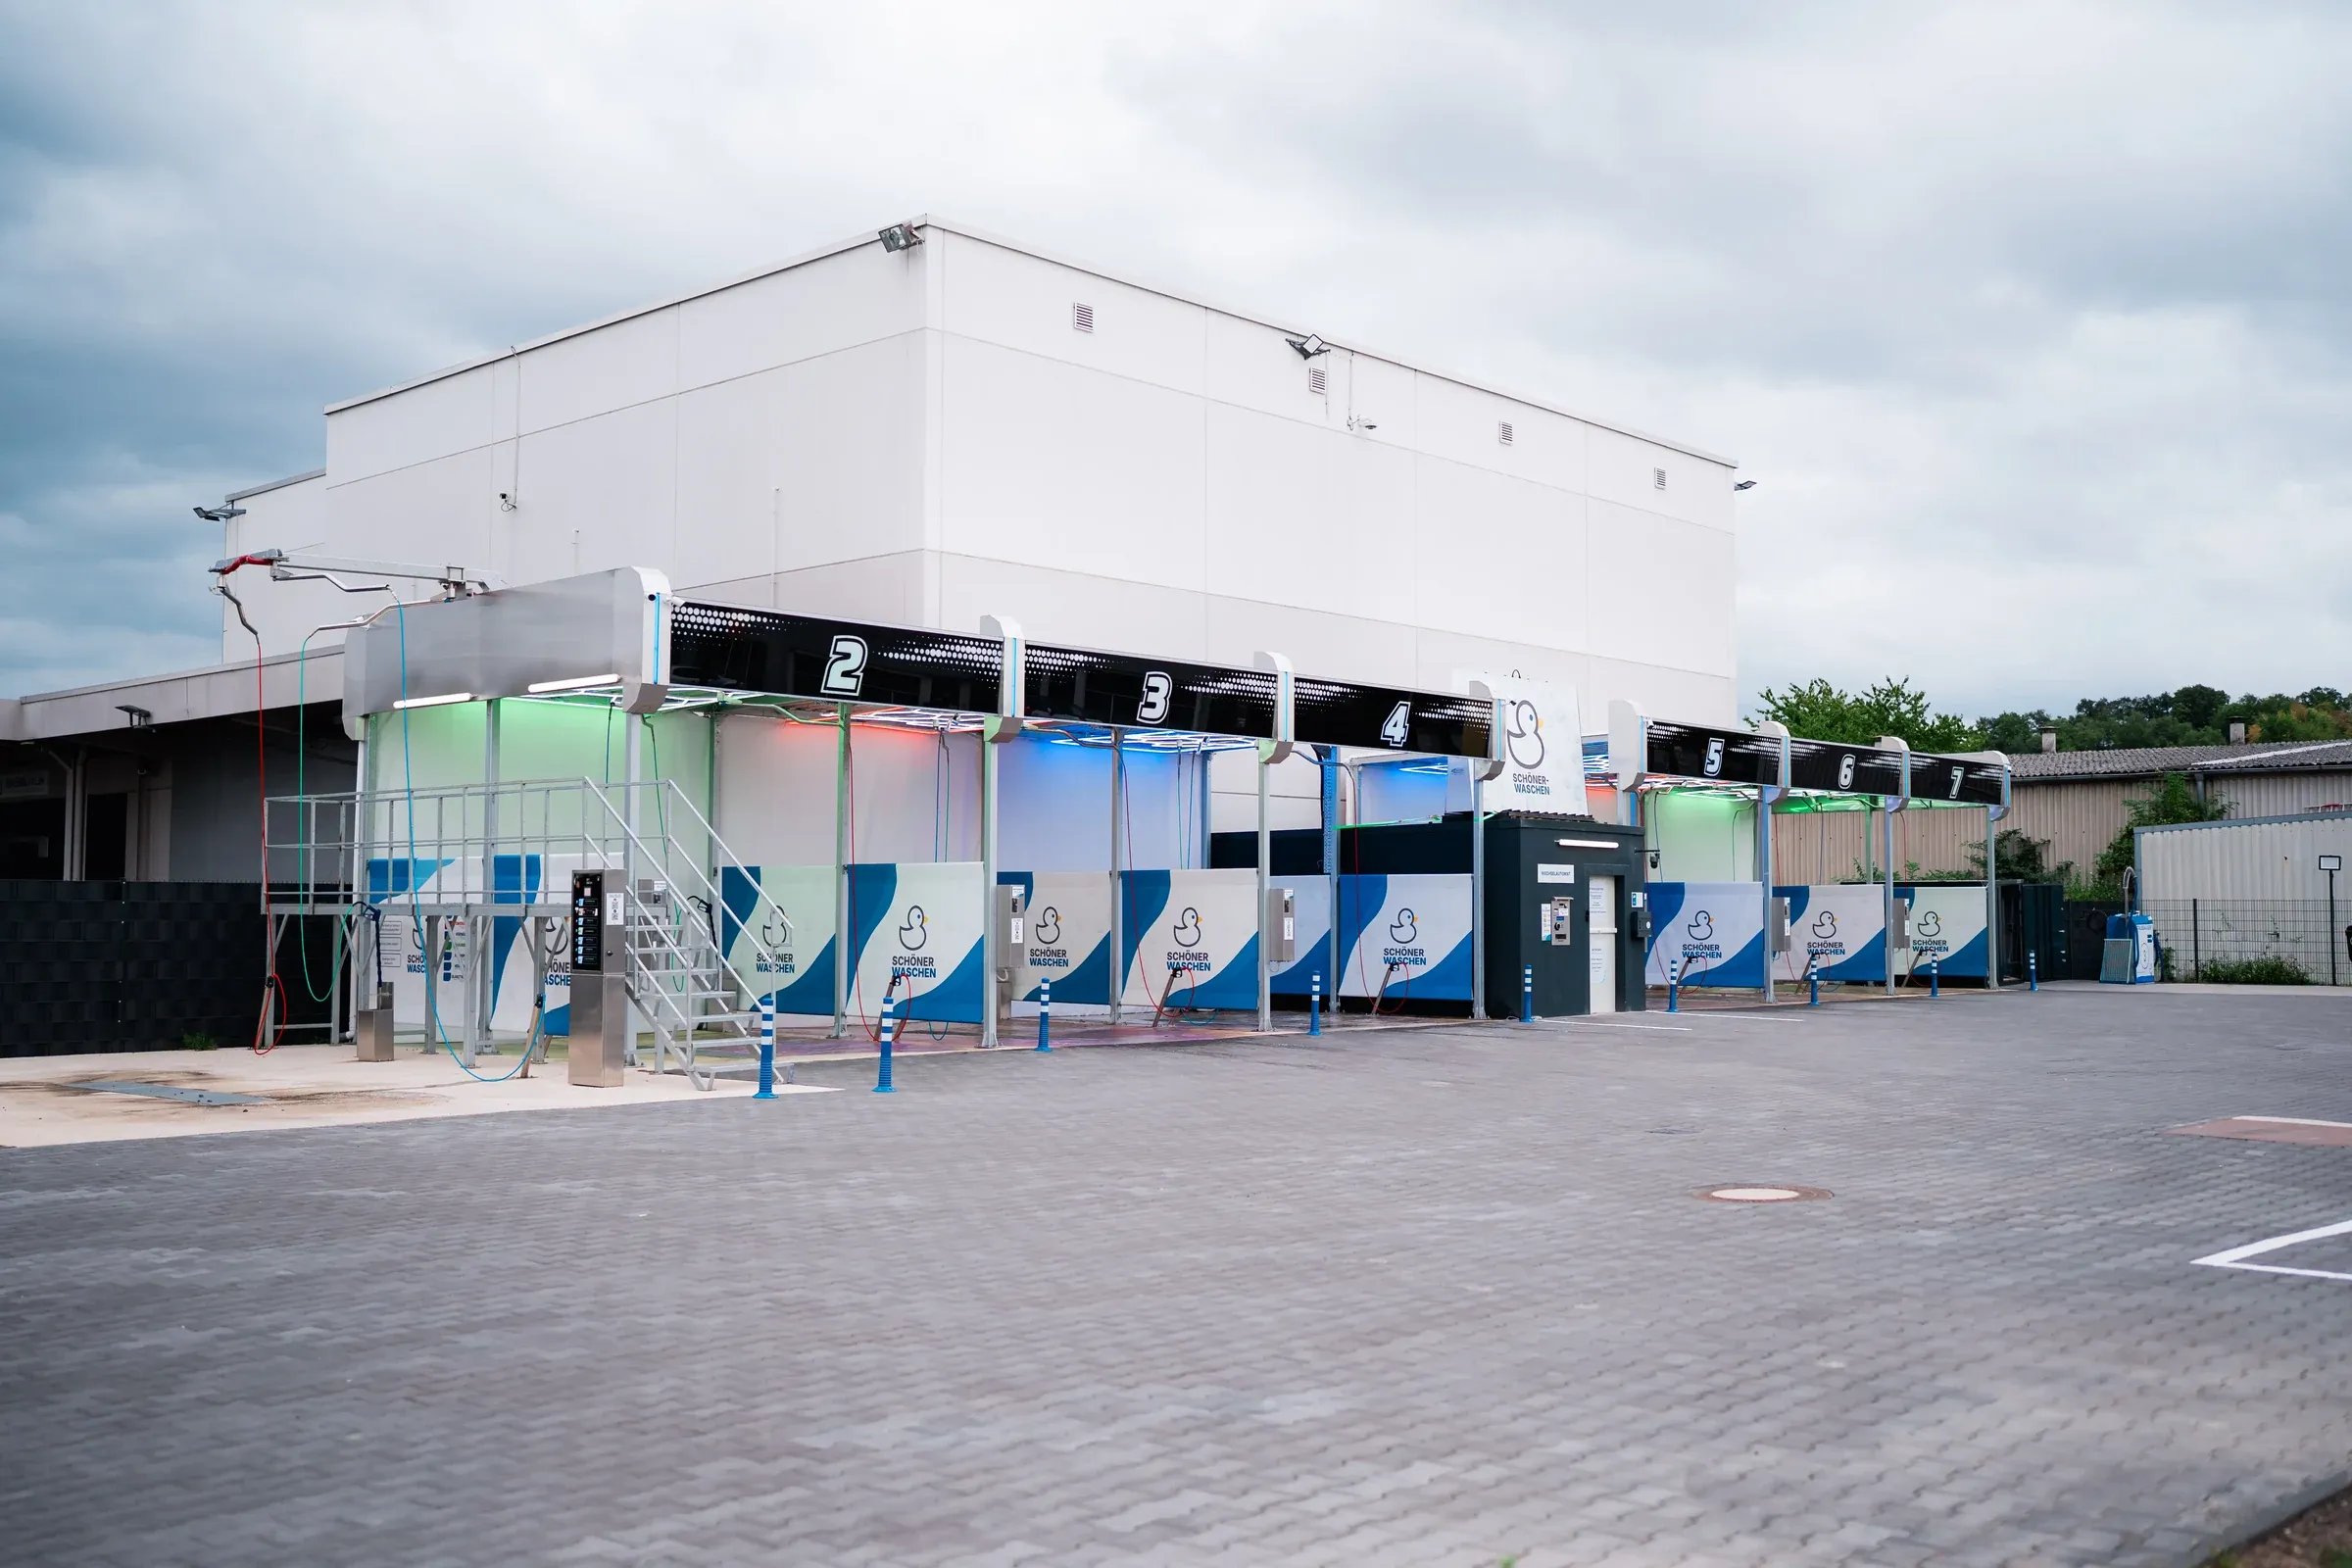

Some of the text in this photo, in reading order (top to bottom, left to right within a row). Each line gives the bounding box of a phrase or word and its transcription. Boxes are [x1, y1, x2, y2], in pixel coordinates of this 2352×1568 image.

[819, 634, 868, 697] 2
[1136, 670, 1173, 724] 3
[1380, 701, 1411, 748] 4
[1703, 737, 1725, 777] 5
[1512, 771, 1549, 785] SCHÖNER-
[1838, 754, 1856, 790] 6
[1514, 783, 1550, 796] WASCHEN
[1949, 765, 1965, 801] 7
[1383, 946, 1425, 956] SCHÖNER
[1682, 942, 1720, 952] SCHÖNER
[1806, 940, 1843, 949] SCHÖNER
[1029, 947, 1067, 958] SCHÖNER
[1166, 950, 1209, 961] SCHÖNER
[892, 954, 934, 967] SCHÖNER
[1029, 957, 1069, 967] WASCHEN
[1166, 961, 1211, 972] WASCHEN
[1383, 956, 1427, 966] WASCHEN
[892, 966, 937, 979] WASCHEN
